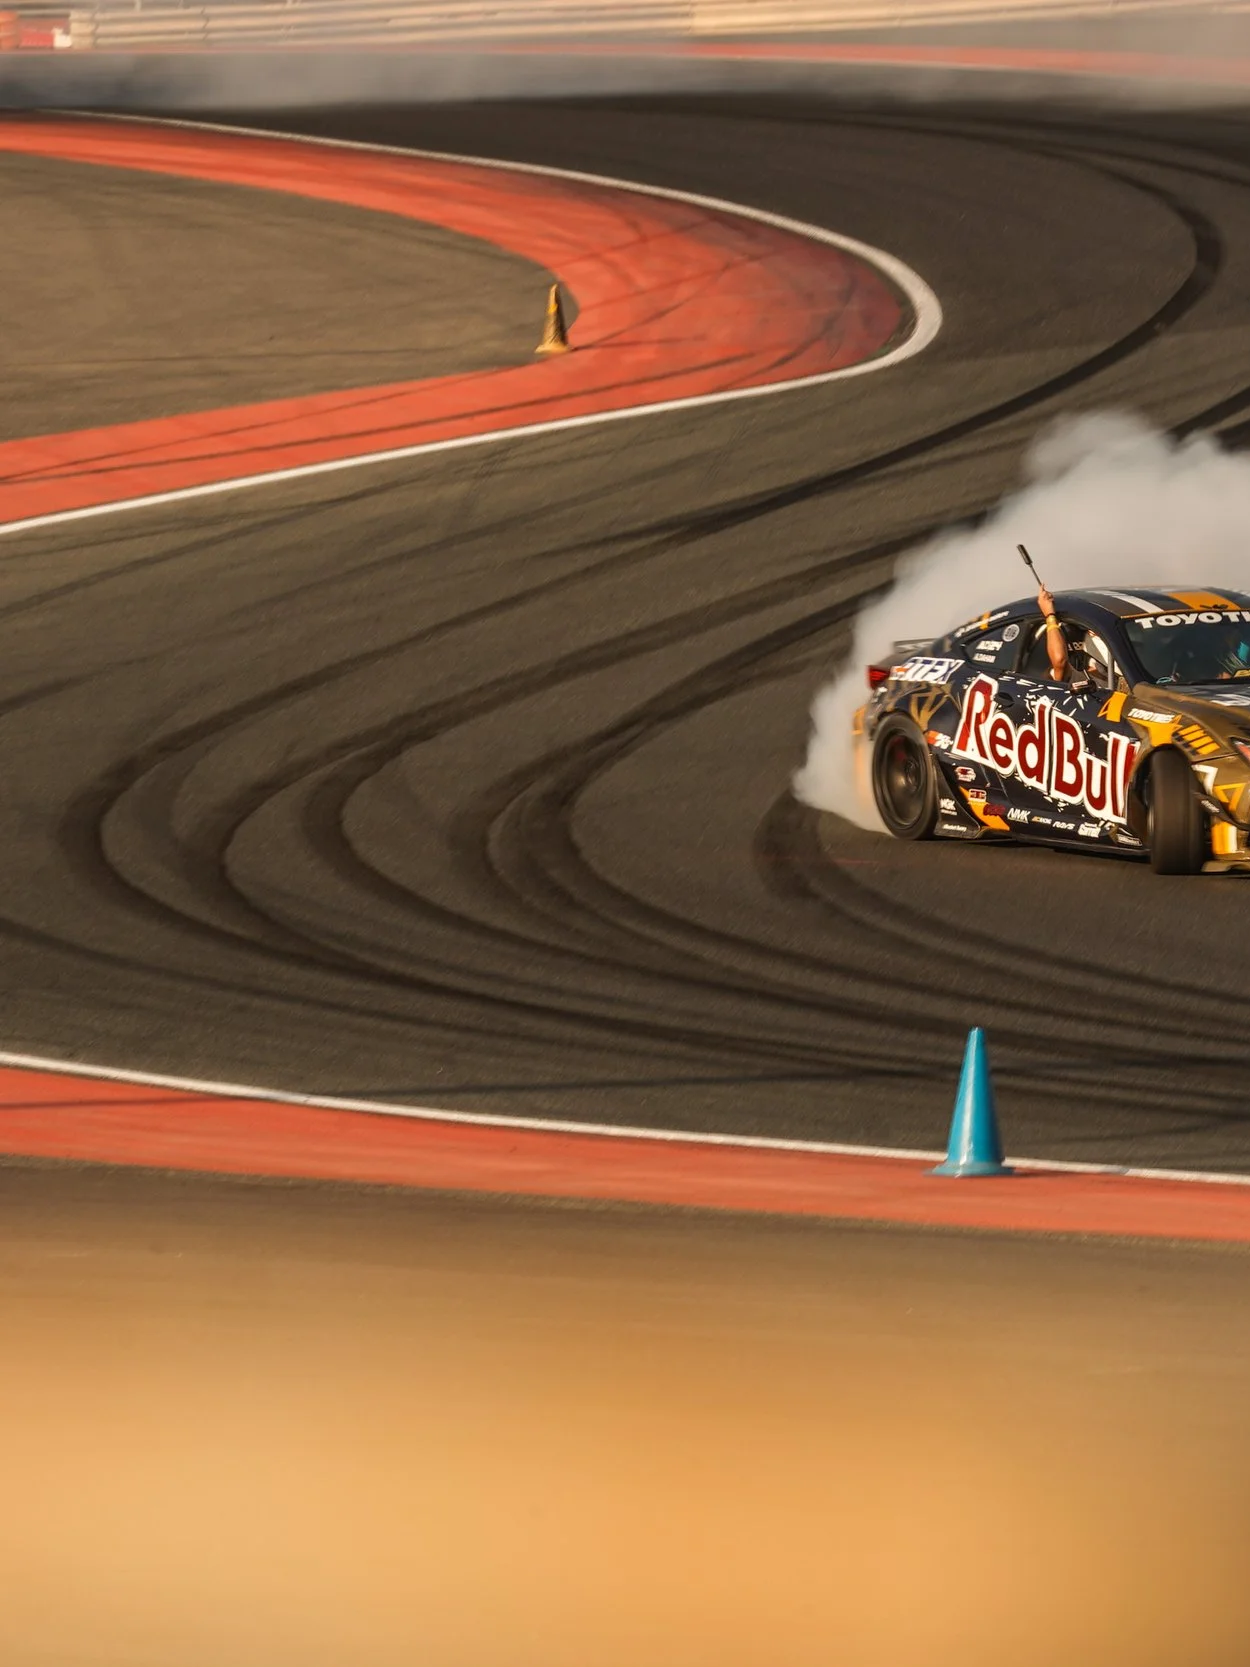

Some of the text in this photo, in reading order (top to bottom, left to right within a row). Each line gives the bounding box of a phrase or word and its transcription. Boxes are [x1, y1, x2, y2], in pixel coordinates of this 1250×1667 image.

[1134, 612, 1222, 630] TOYO
[1127, 708, 1153, 721] TOYO
[952, 674, 1140, 825] Red Bull
[1007, 807, 1031, 824] NMK
